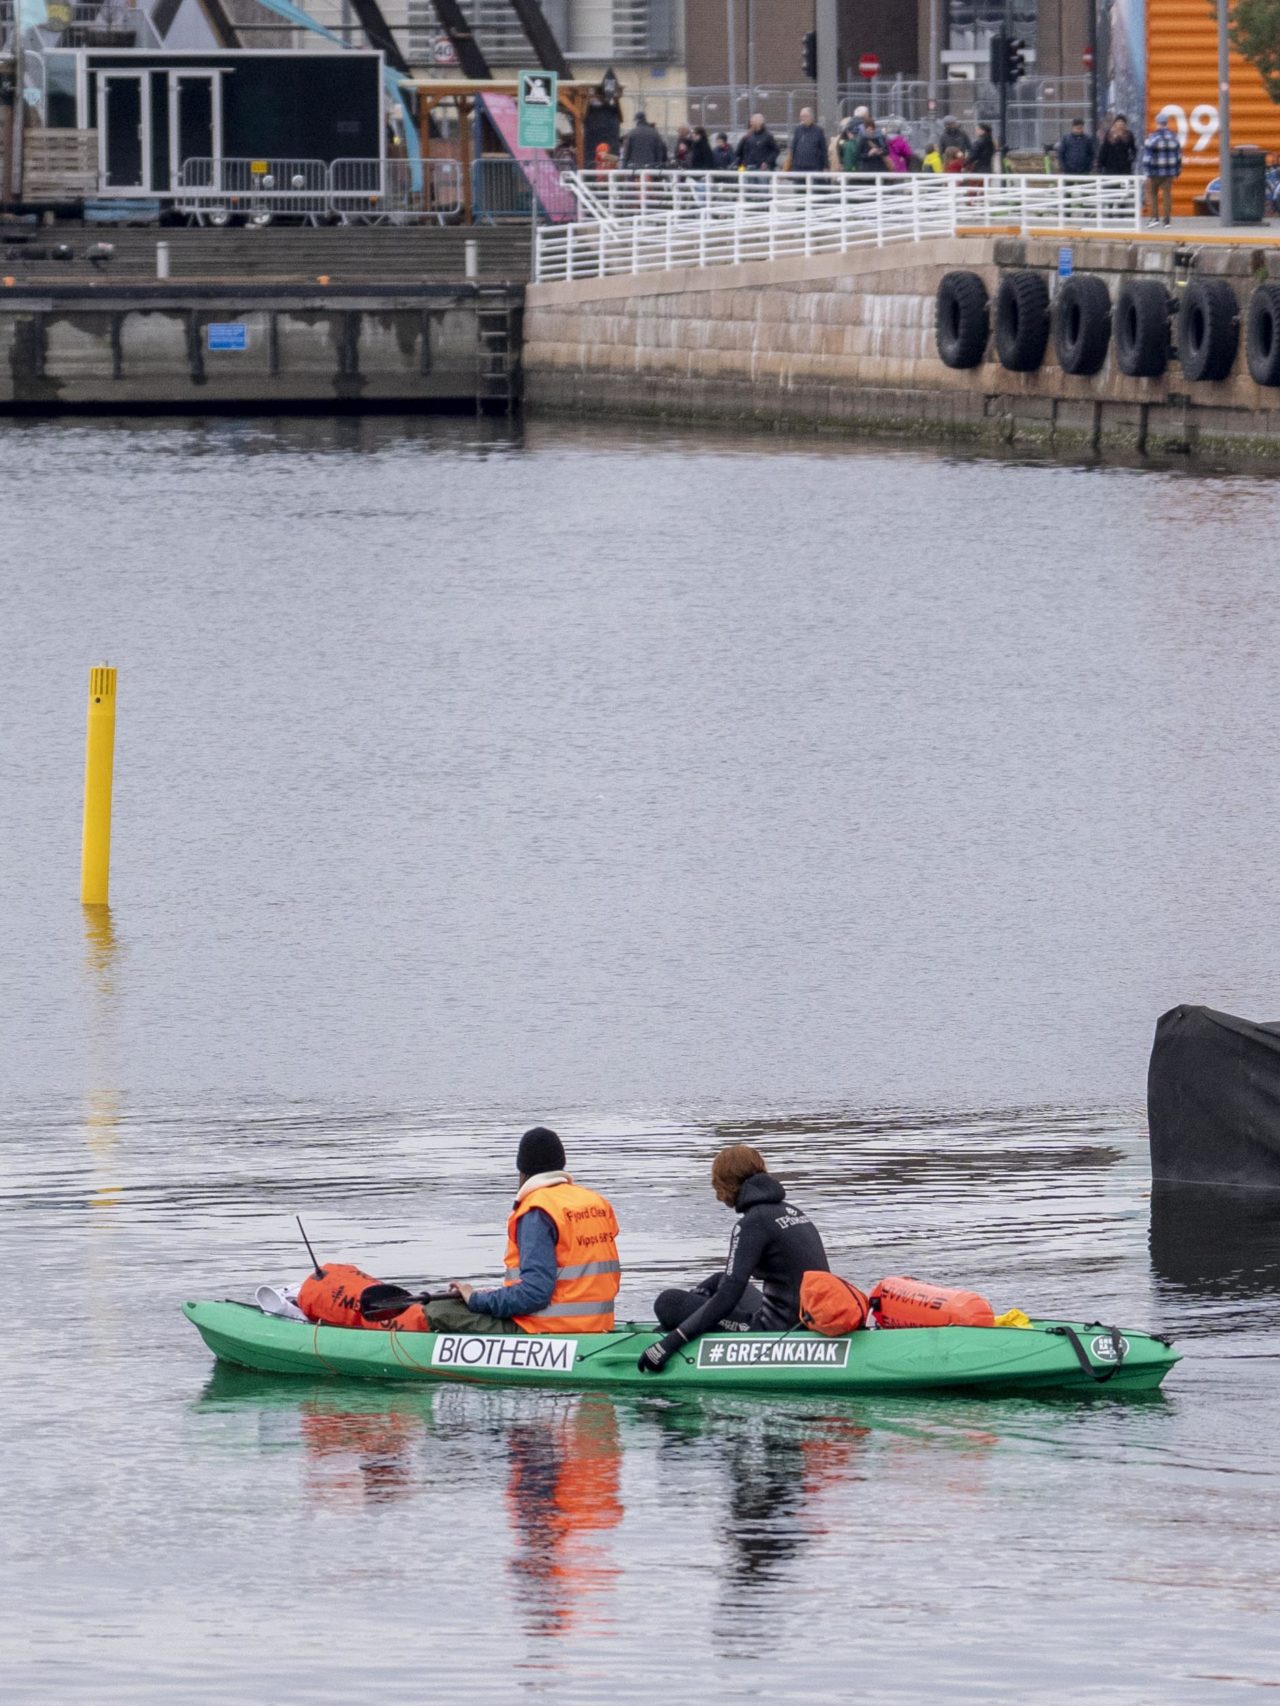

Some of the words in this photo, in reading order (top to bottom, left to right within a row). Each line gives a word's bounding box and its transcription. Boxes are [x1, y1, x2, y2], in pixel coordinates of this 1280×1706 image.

[435, 42, 452, 56] 40
[438, 1337, 568, 1369] BIOTHERM
[708, 1342, 839, 1363] #GREENKAYAK
